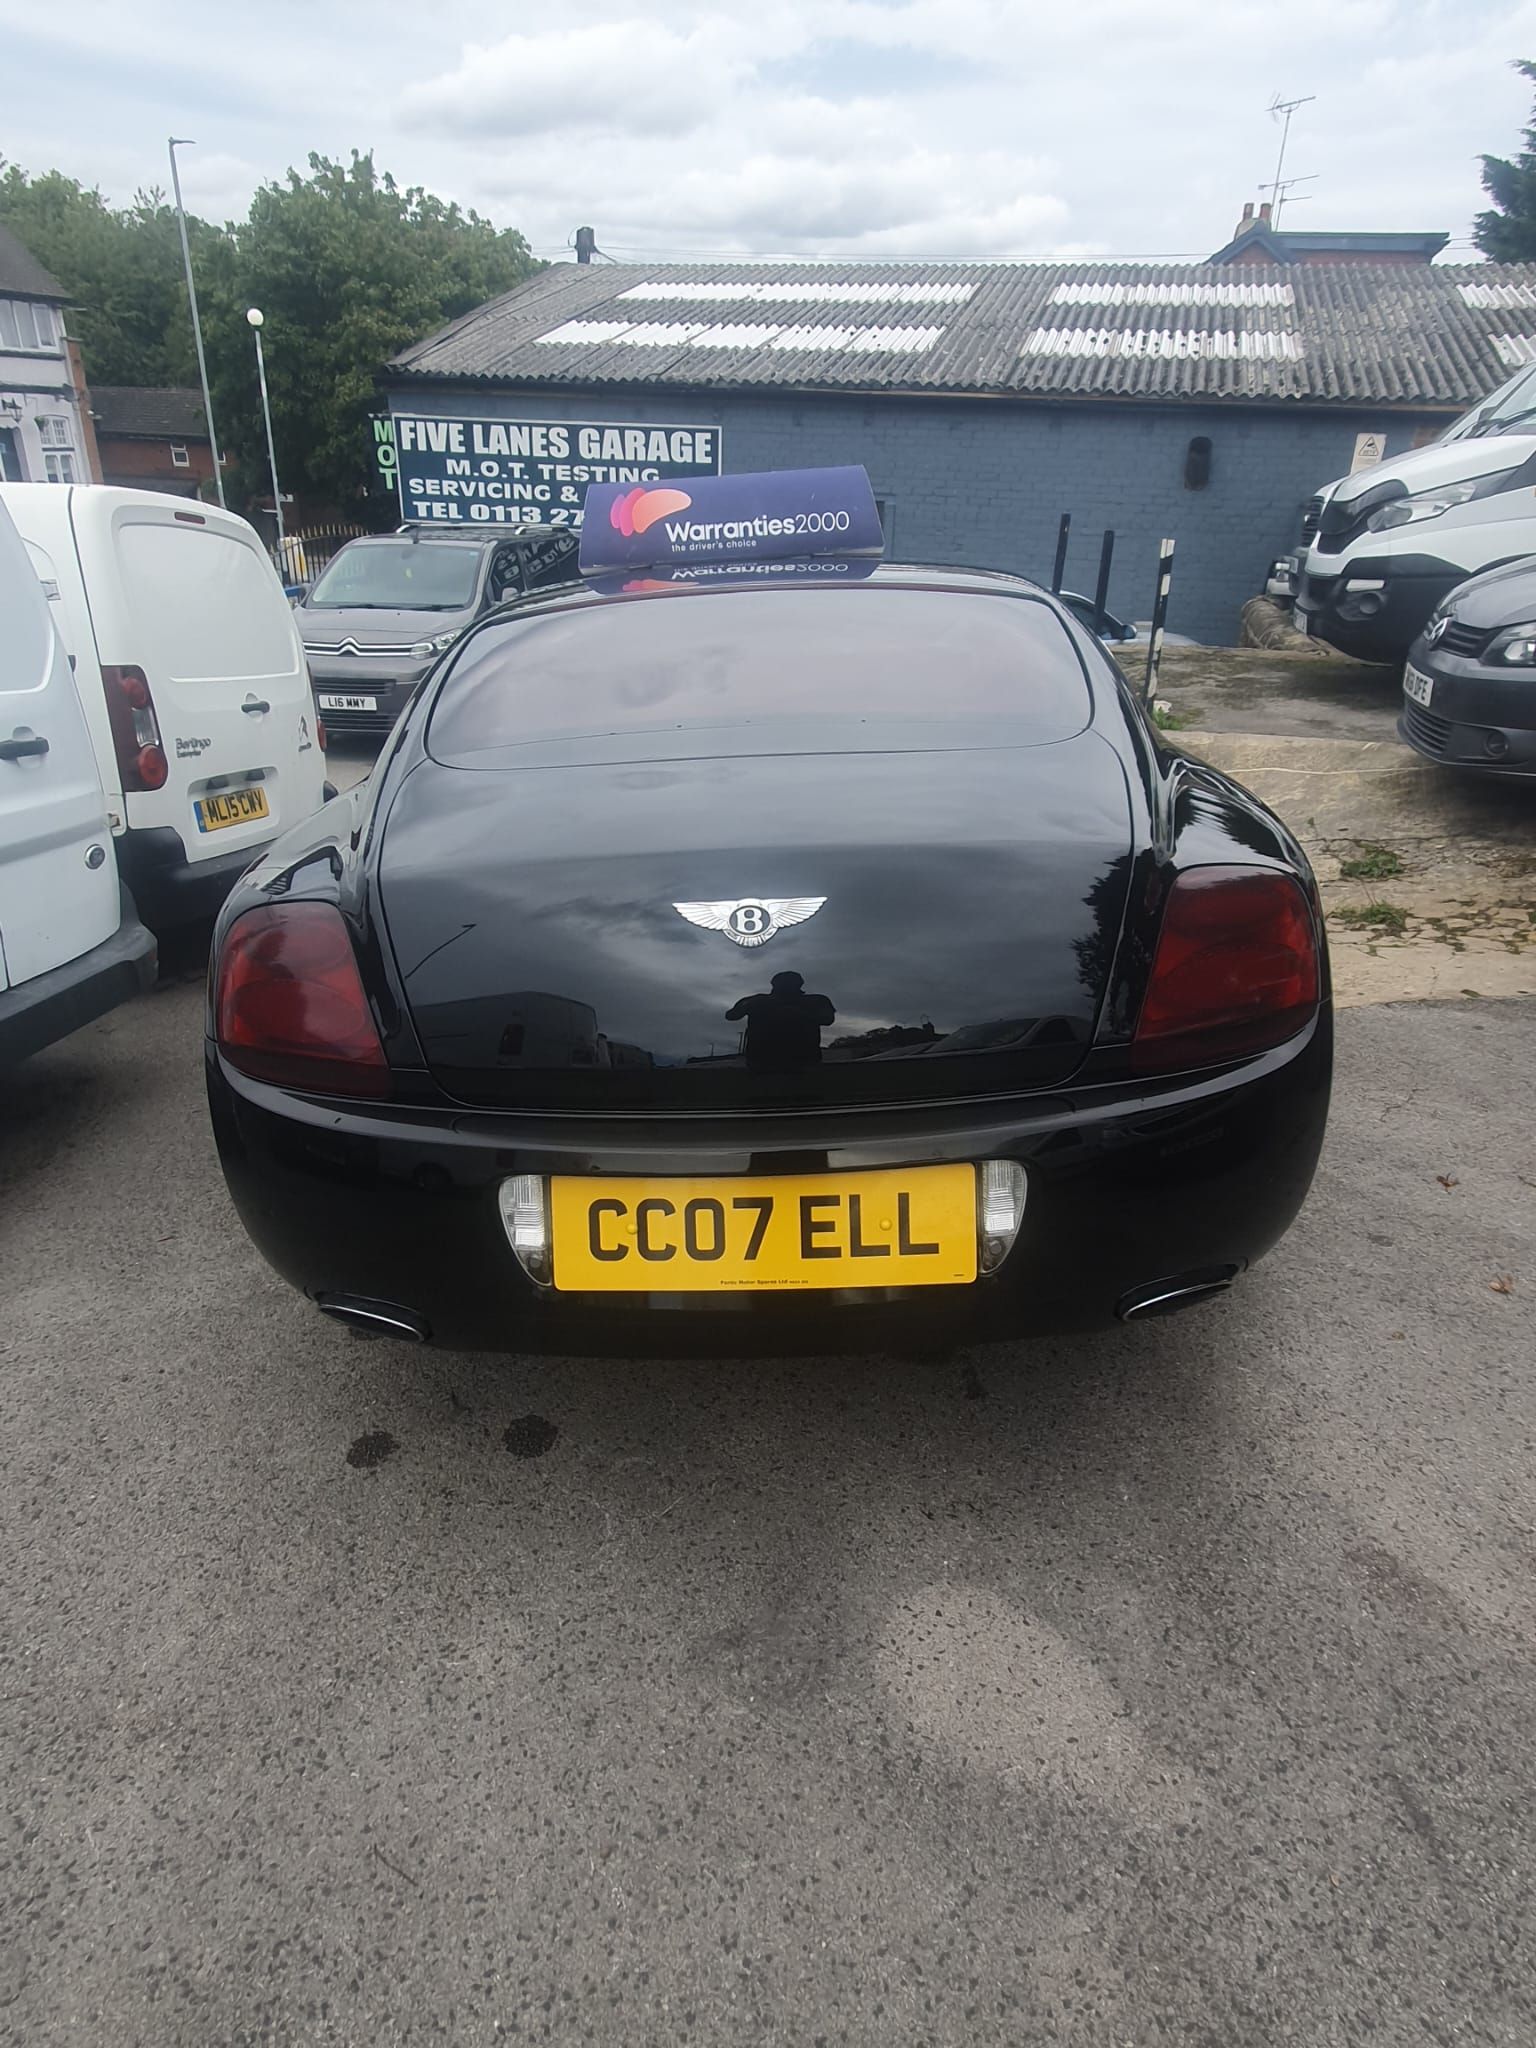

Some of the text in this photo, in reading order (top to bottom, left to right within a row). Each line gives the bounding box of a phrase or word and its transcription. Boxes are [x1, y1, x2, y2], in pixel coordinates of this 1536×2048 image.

[373, 420, 397, 490] MOT
[400, 420, 713, 464] FIVE LANES GARAGE
[446, 458, 660, 484] M.O.T. TESTING
[408, 478, 580, 503] SERVICING &
[412, 501, 463, 520] TEL
[469, 503, 542, 524] 0113
[664, 510, 851, 543] Warranties2000
[671, 538, 757, 553] the driver's choice
[589, 1192, 940, 1262] CC07 ELL
